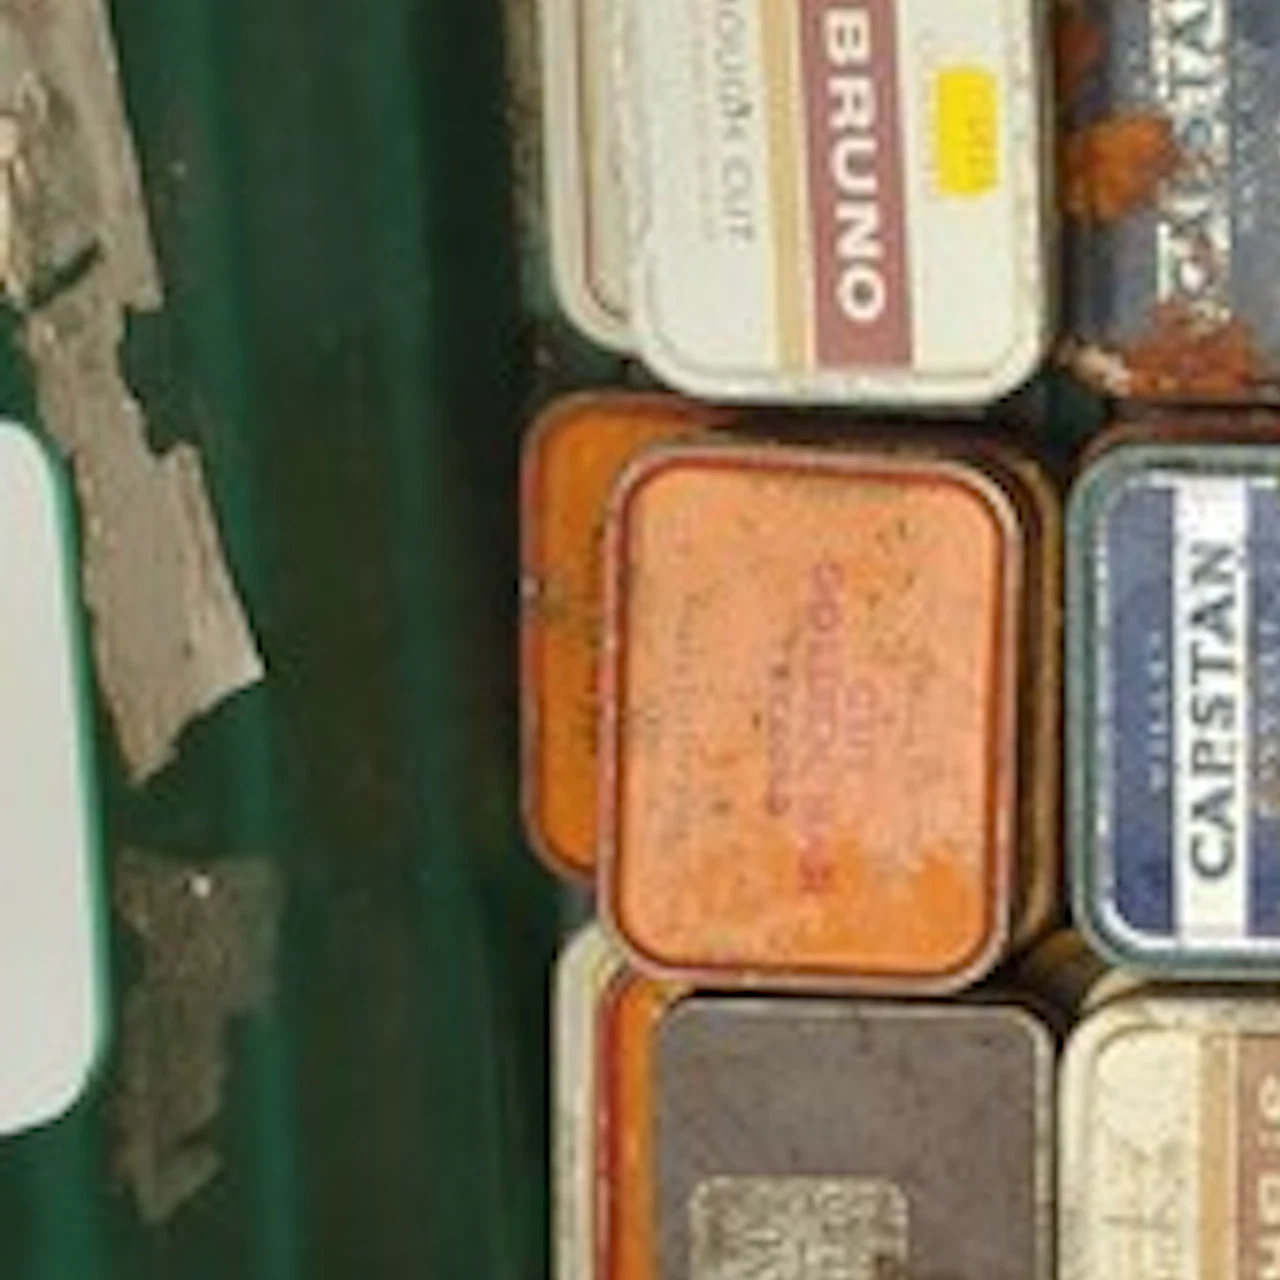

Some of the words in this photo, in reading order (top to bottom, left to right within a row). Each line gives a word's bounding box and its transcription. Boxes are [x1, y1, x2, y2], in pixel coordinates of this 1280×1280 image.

[720, 152, 756, 245] CUT
[825, 9, 887, 321] BRUNO
[1190, 540, 1240, 880] CAPSTAN
